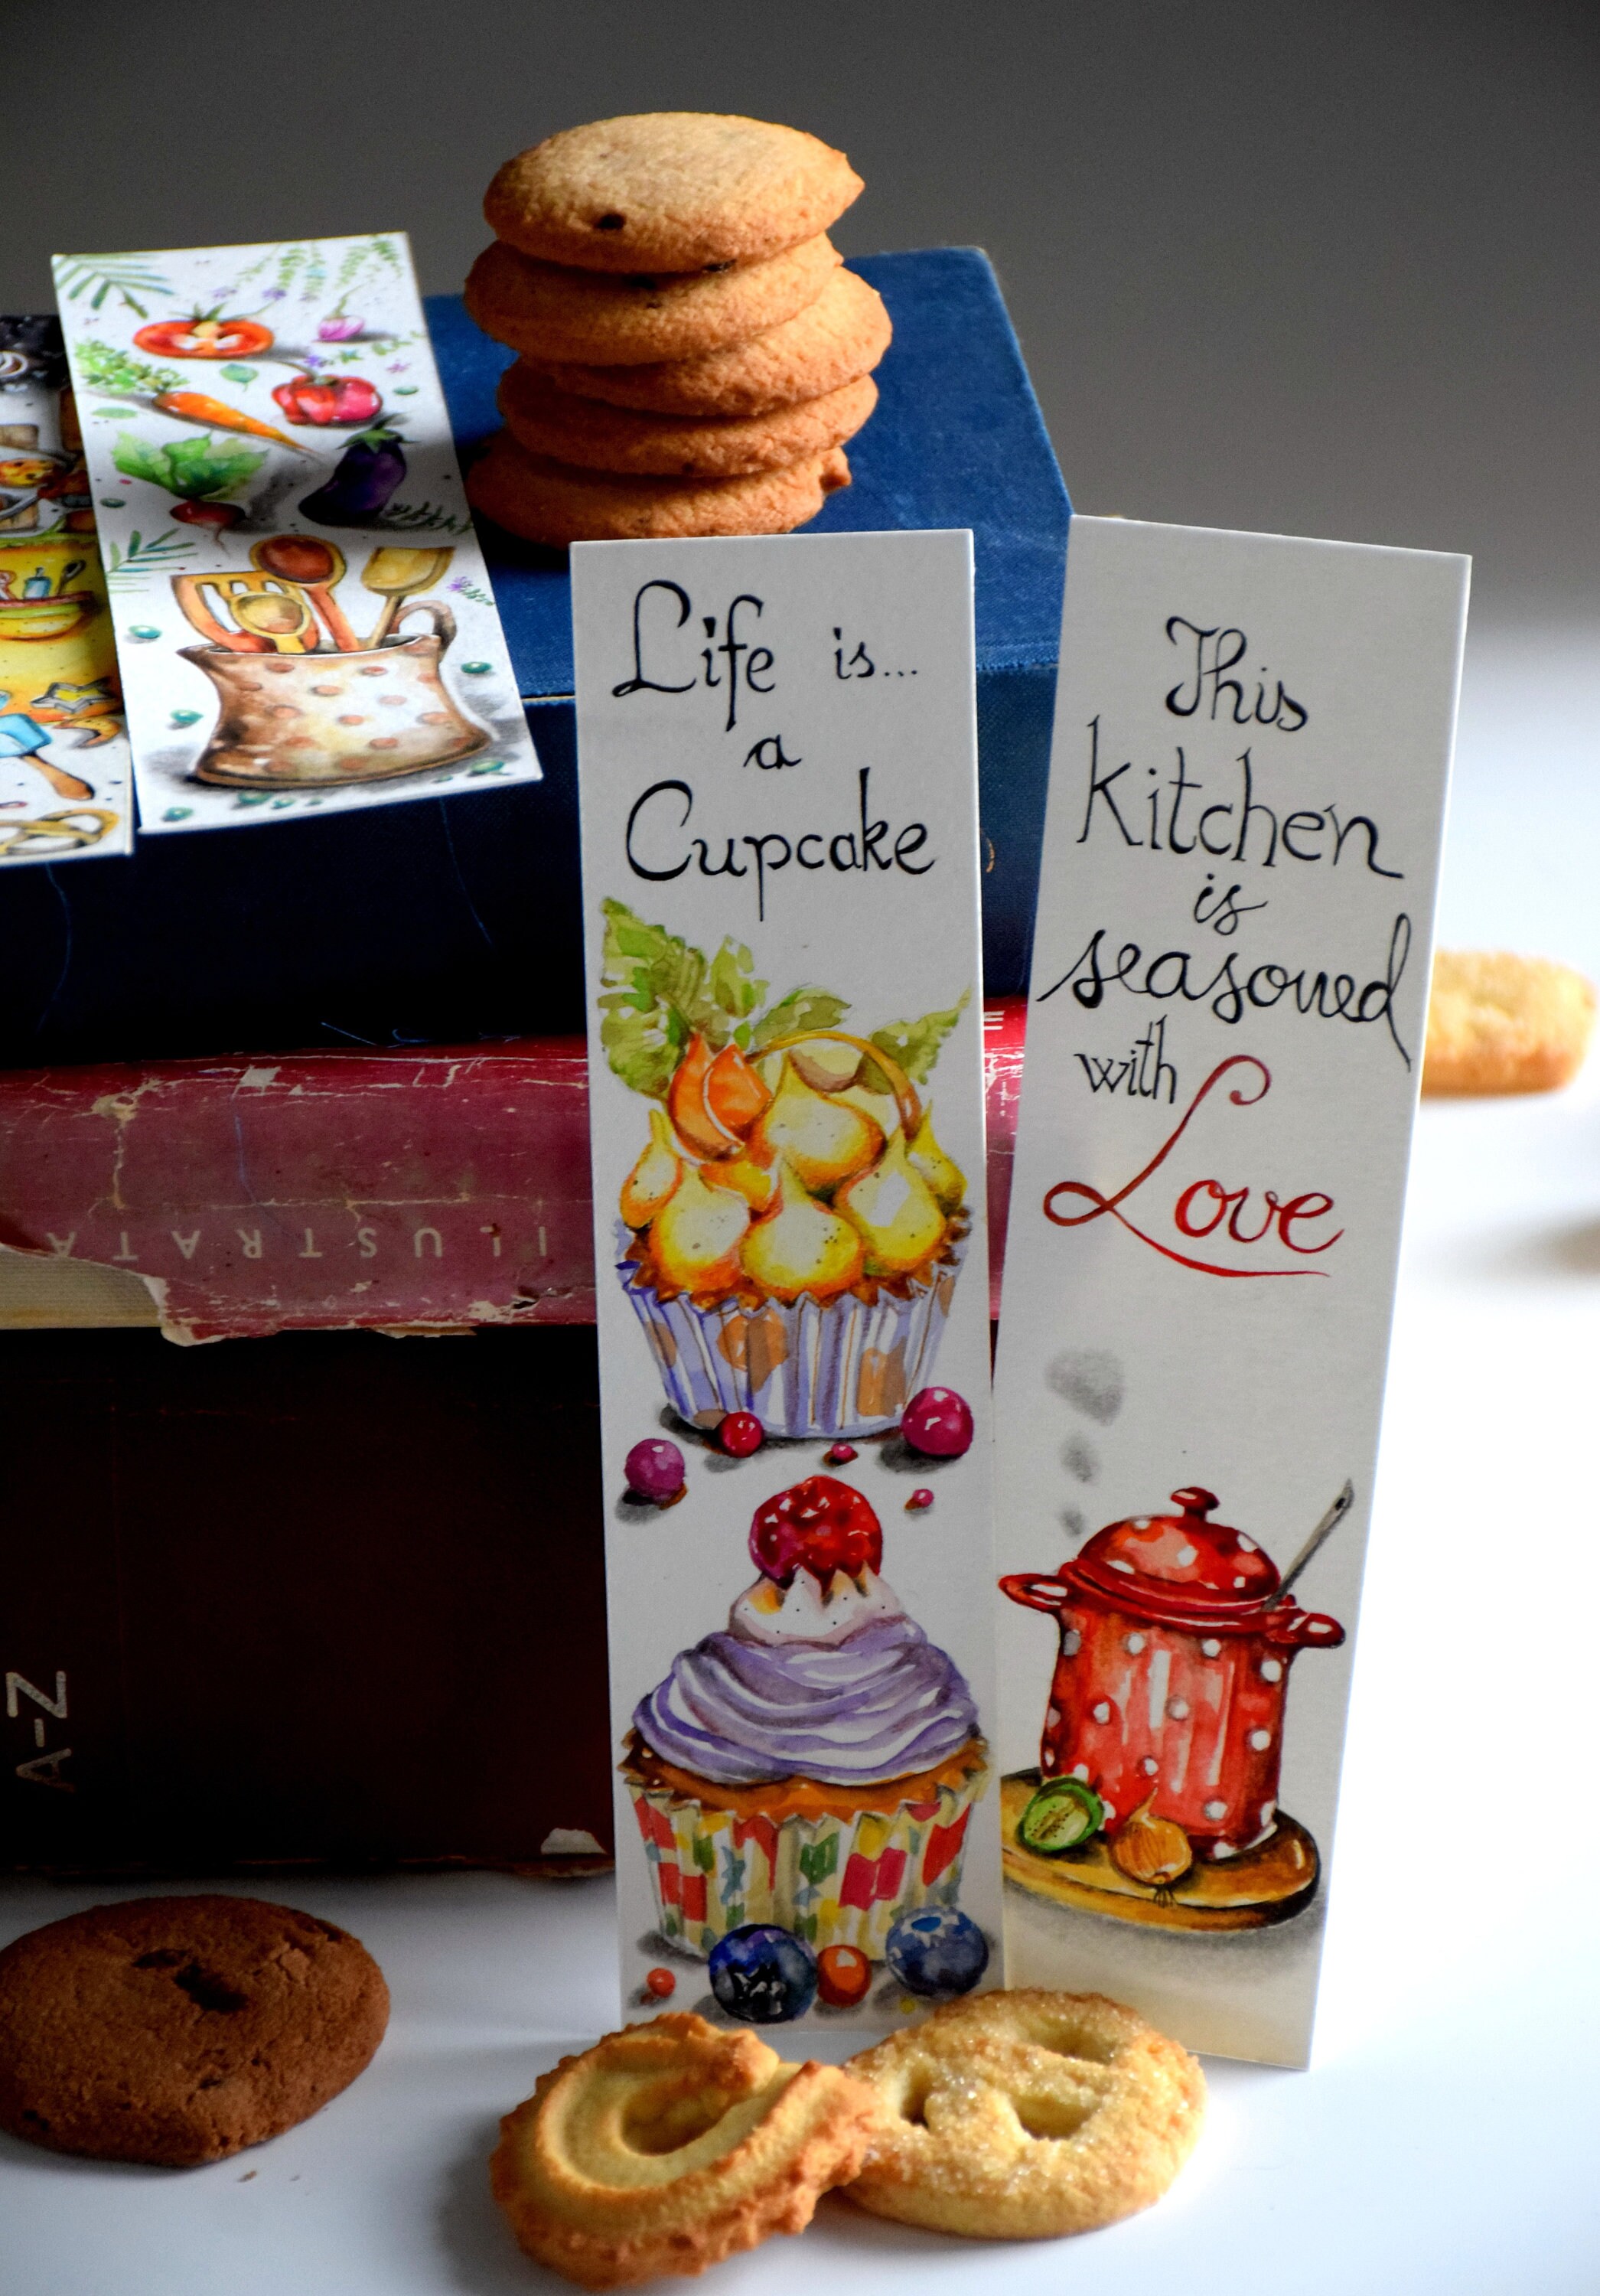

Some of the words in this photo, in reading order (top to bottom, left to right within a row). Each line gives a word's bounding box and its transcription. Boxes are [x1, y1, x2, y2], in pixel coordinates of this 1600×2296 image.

[612, 579, 777, 732] Life
[833, 627, 918, 680] is...
[1165, 615, 1308, 732] This
[743, 734, 802, 770] a
[625, 767, 935, 922] Cupcake
[1193, 872, 1269, 936] is
[1036, 912, 1412, 1073] seasoned
[1073, 1014, 1178, 1104] with
[1043, 1054, 1345, 1278] Love
